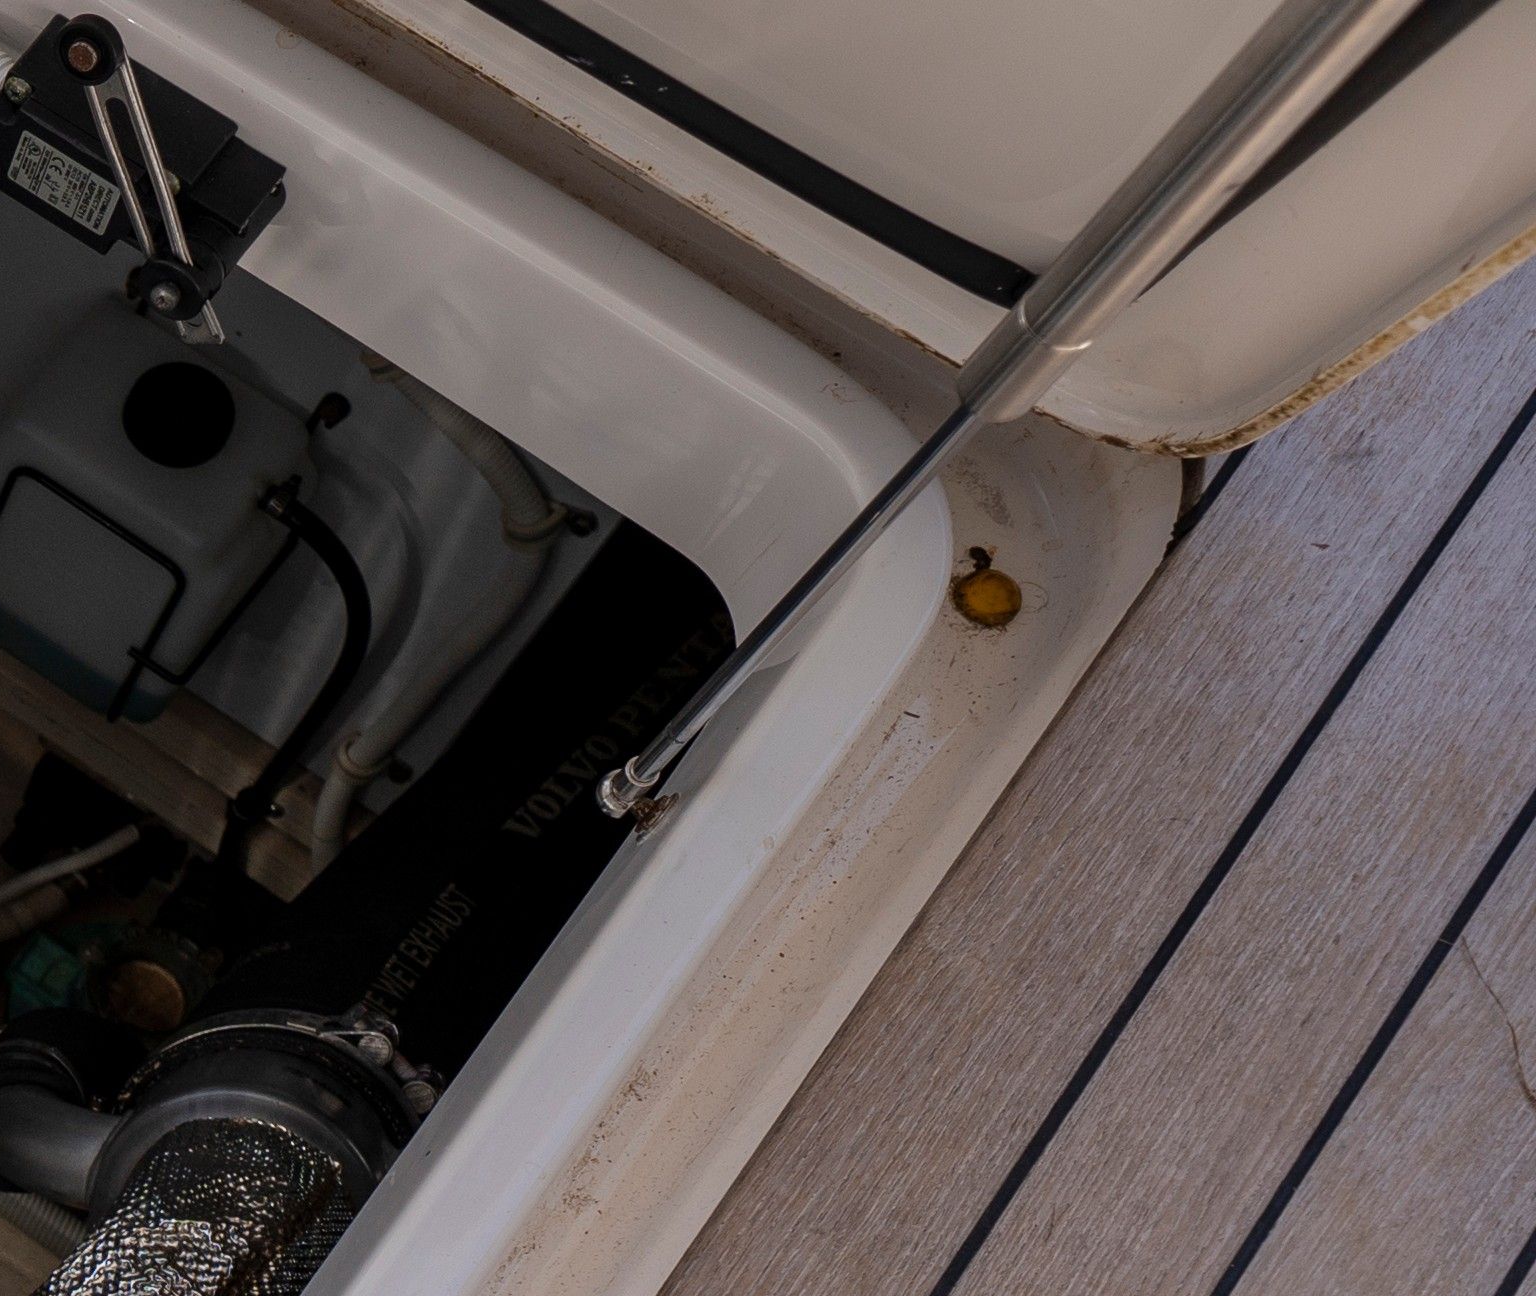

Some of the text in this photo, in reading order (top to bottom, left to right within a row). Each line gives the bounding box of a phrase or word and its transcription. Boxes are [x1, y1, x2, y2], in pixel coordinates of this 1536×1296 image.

[93, 188, 114, 229] AUTOMATION
[500, 734, 620, 838] VOLVO
[369, 953, 421, 1001] WET
[399, 882, 478, 968] EXHAUST
